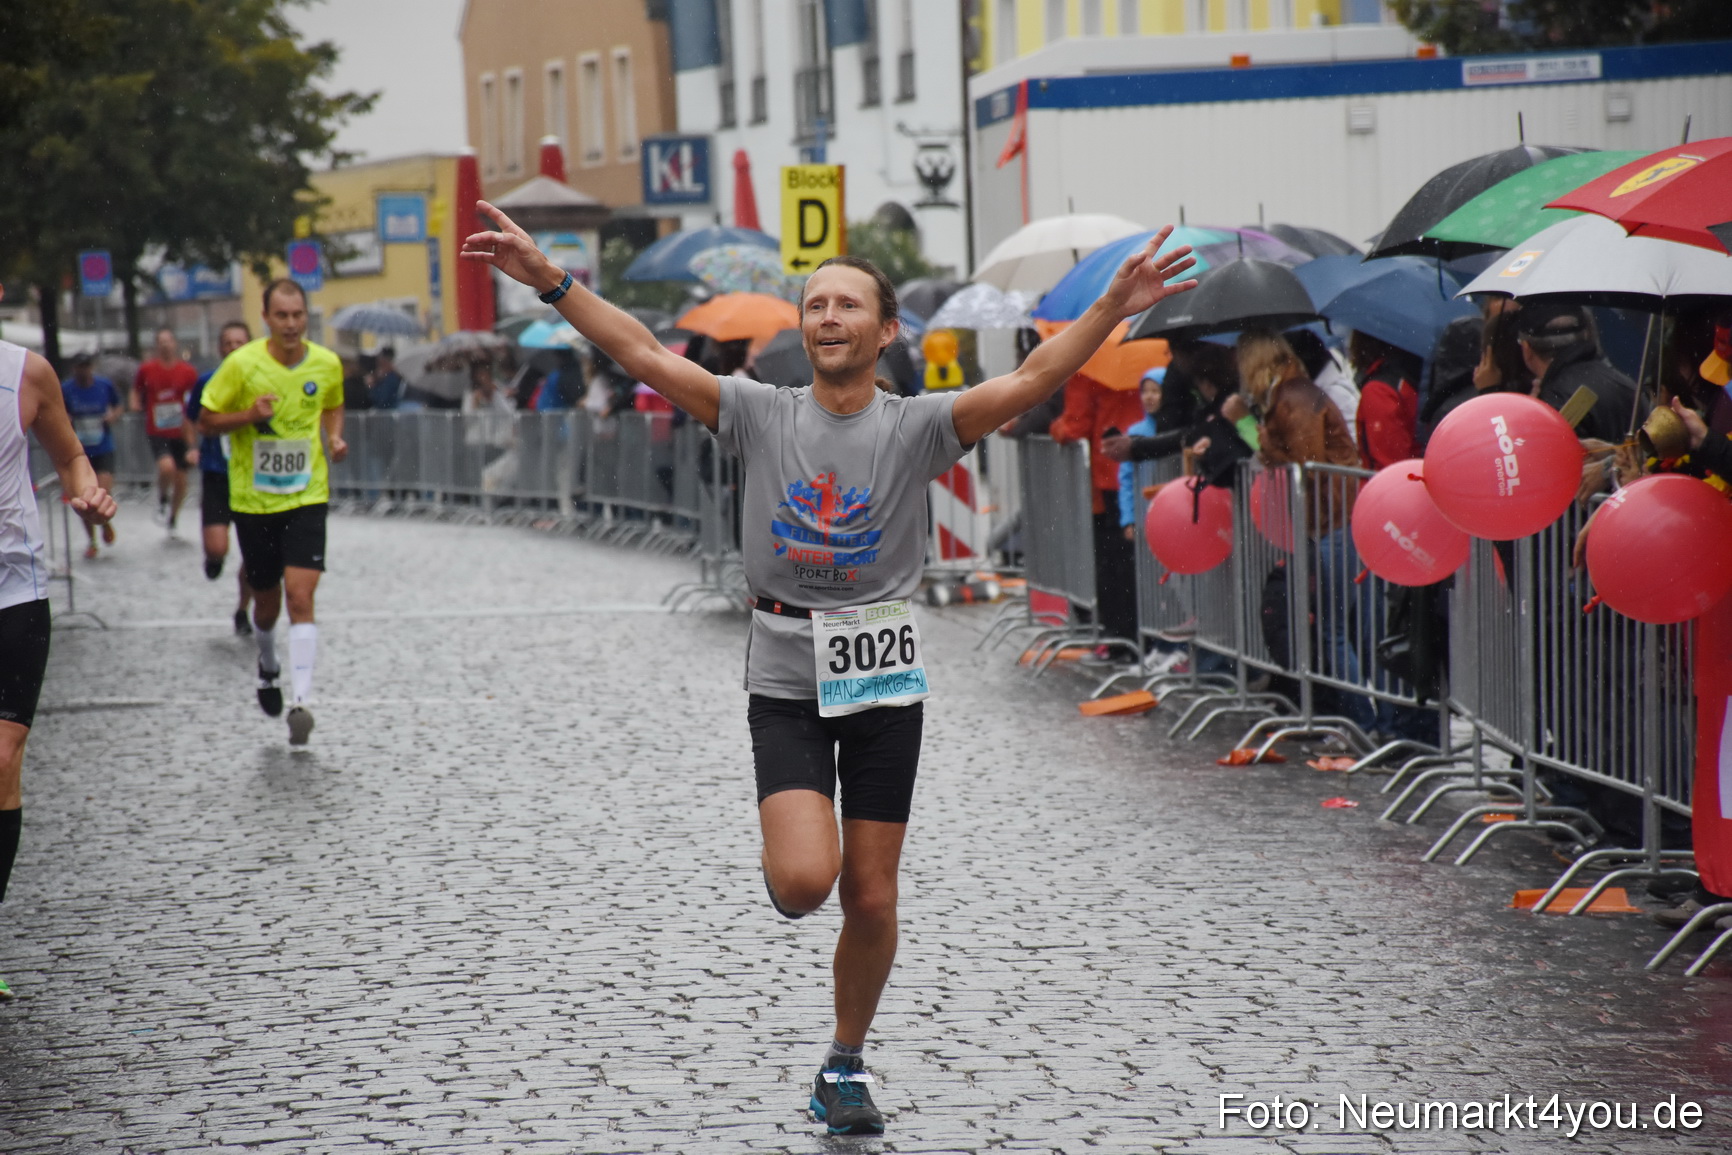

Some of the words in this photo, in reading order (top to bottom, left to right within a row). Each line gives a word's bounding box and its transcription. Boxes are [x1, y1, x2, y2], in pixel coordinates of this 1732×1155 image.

[788, 167, 839, 190] Block
[798, 198, 829, 249] D
[260, 452, 306, 473] 2880
[1490, 415, 1527, 497] RÖDL
[1494, 457, 1506, 497] energie
[790, 526, 870, 547] FINISHER
[787, 546, 879, 566] INTERSPORT
[798, 583, 854, 592] www.sportbox.com
[865, 602, 910, 621] BOCK
[822, 619, 861, 628] NeuerMarkt
[828, 624, 916, 675] 3026
